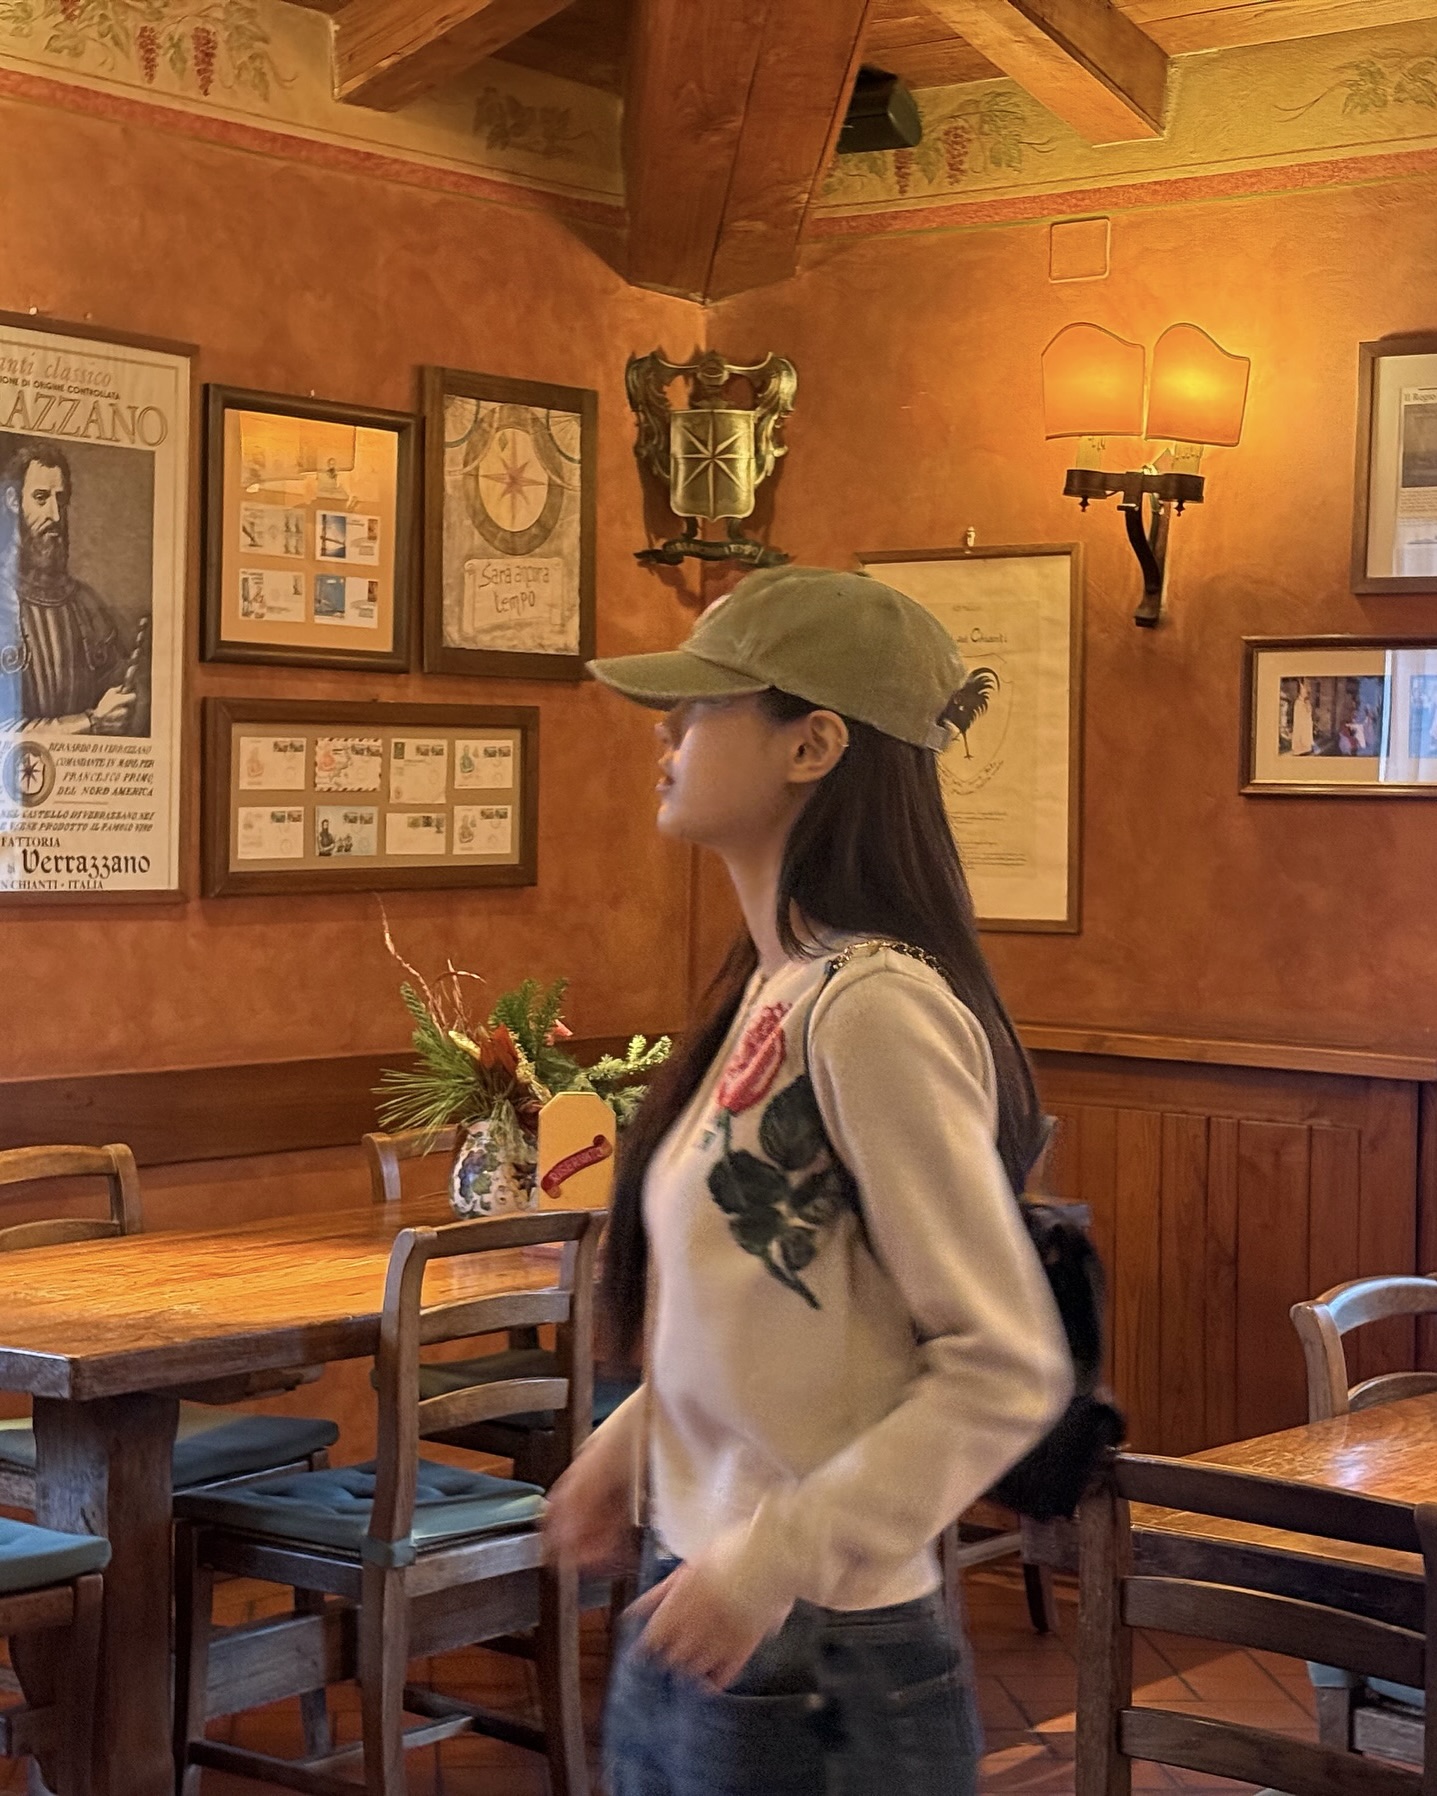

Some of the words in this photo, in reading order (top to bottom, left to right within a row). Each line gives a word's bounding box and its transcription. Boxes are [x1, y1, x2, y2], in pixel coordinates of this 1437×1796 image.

[44, 356, 112, 388] classico
[67, 385, 120, 400] CONTROLLATA
[0, 389, 169, 447] AZZANO
[62, 772, 121, 782] FRANCESCO
[57, 786, 77, 796] DEL
[81, 786, 110, 796] NORD
[111, 787, 153, 797] AMERICA
[22, 809, 69, 819] CASTELLO
[39, 821, 88, 832] PRODOTTO
[1, 836, 61, 848] FATTORIA
[22, 848, 150, 879] Verrazzano
[10, 879, 58, 890] CHIANTI
[68, 880, 103, 890] ITALIA
